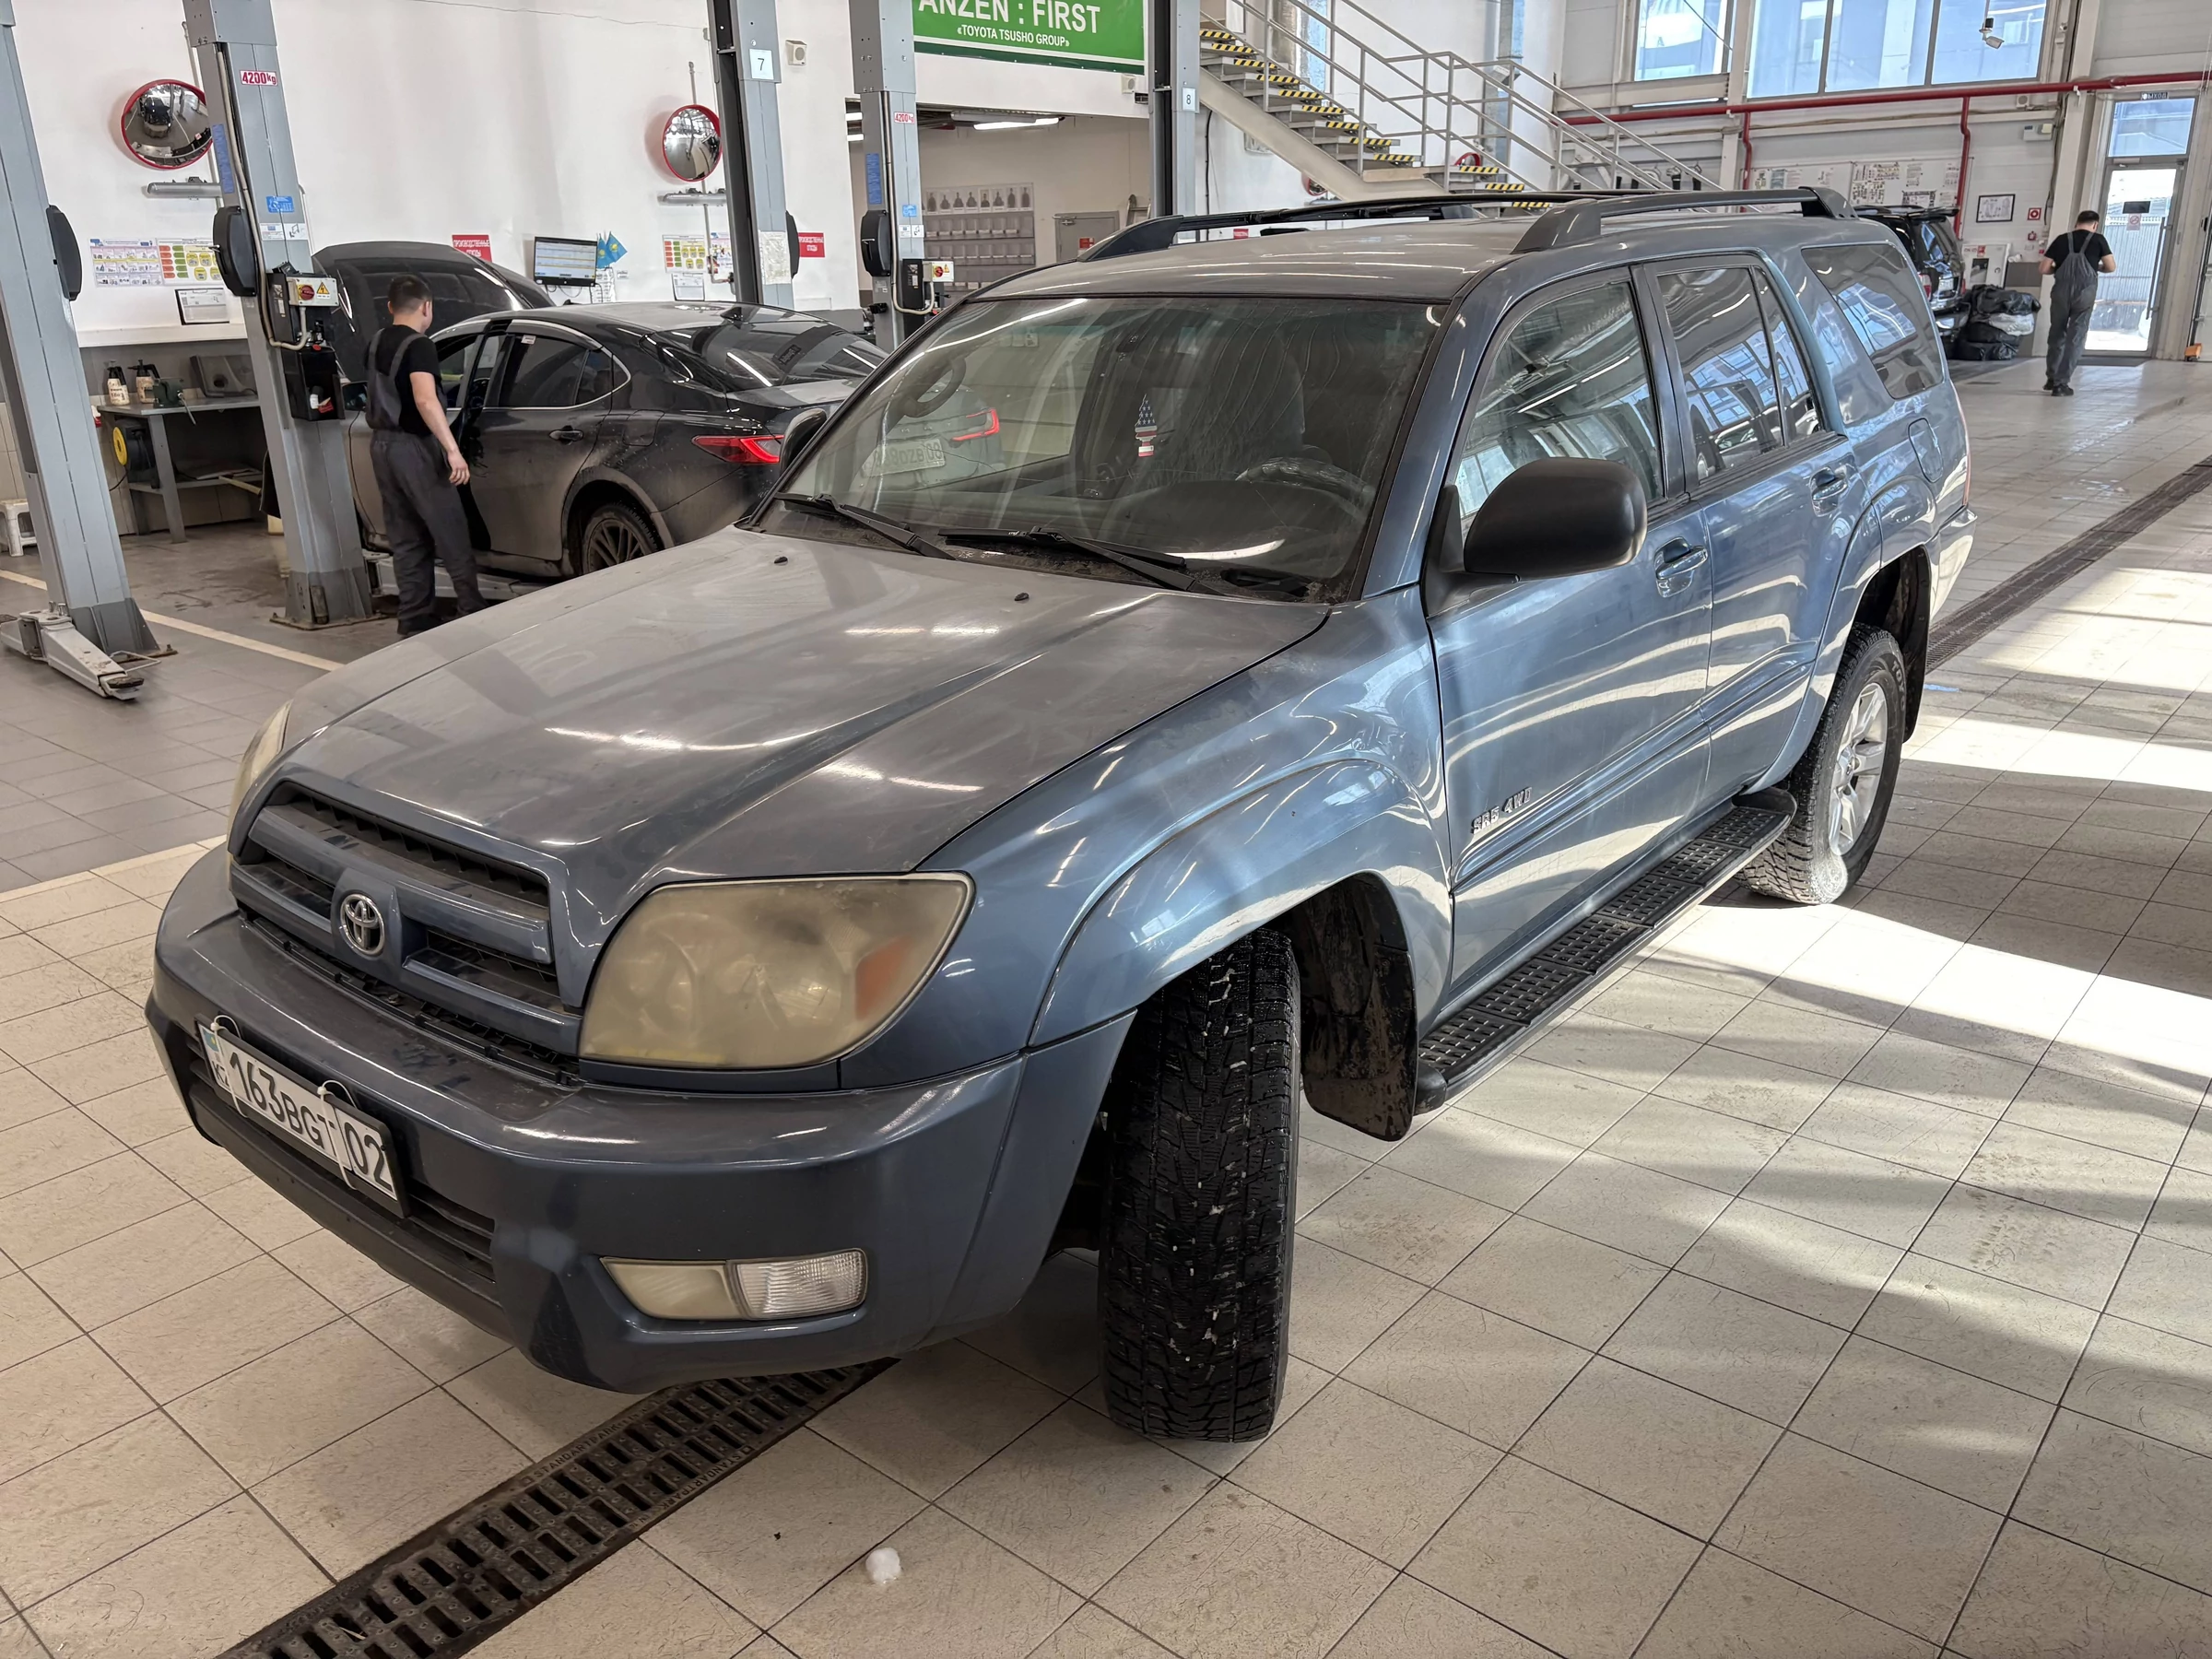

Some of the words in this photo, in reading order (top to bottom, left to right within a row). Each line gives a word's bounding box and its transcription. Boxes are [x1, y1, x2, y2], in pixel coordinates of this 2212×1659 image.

[1032, 0, 1100, 33] FIRST
[957, 24, 997, 39] «TOYOTA
[999, 29, 1033, 43] TSUSHO
[1035, 33, 1069, 47] GROUP»
[757, 57, 765, 71] 7
[241, 71, 276, 85] 4200kg
[1185, 94, 1192, 105] 8
[1471, 806, 1500, 834] SR5
[1501, 786, 1532, 813] 4WD
[229, 1052, 337, 1159] 163BGT
[344, 1122, 394, 1194] 02
